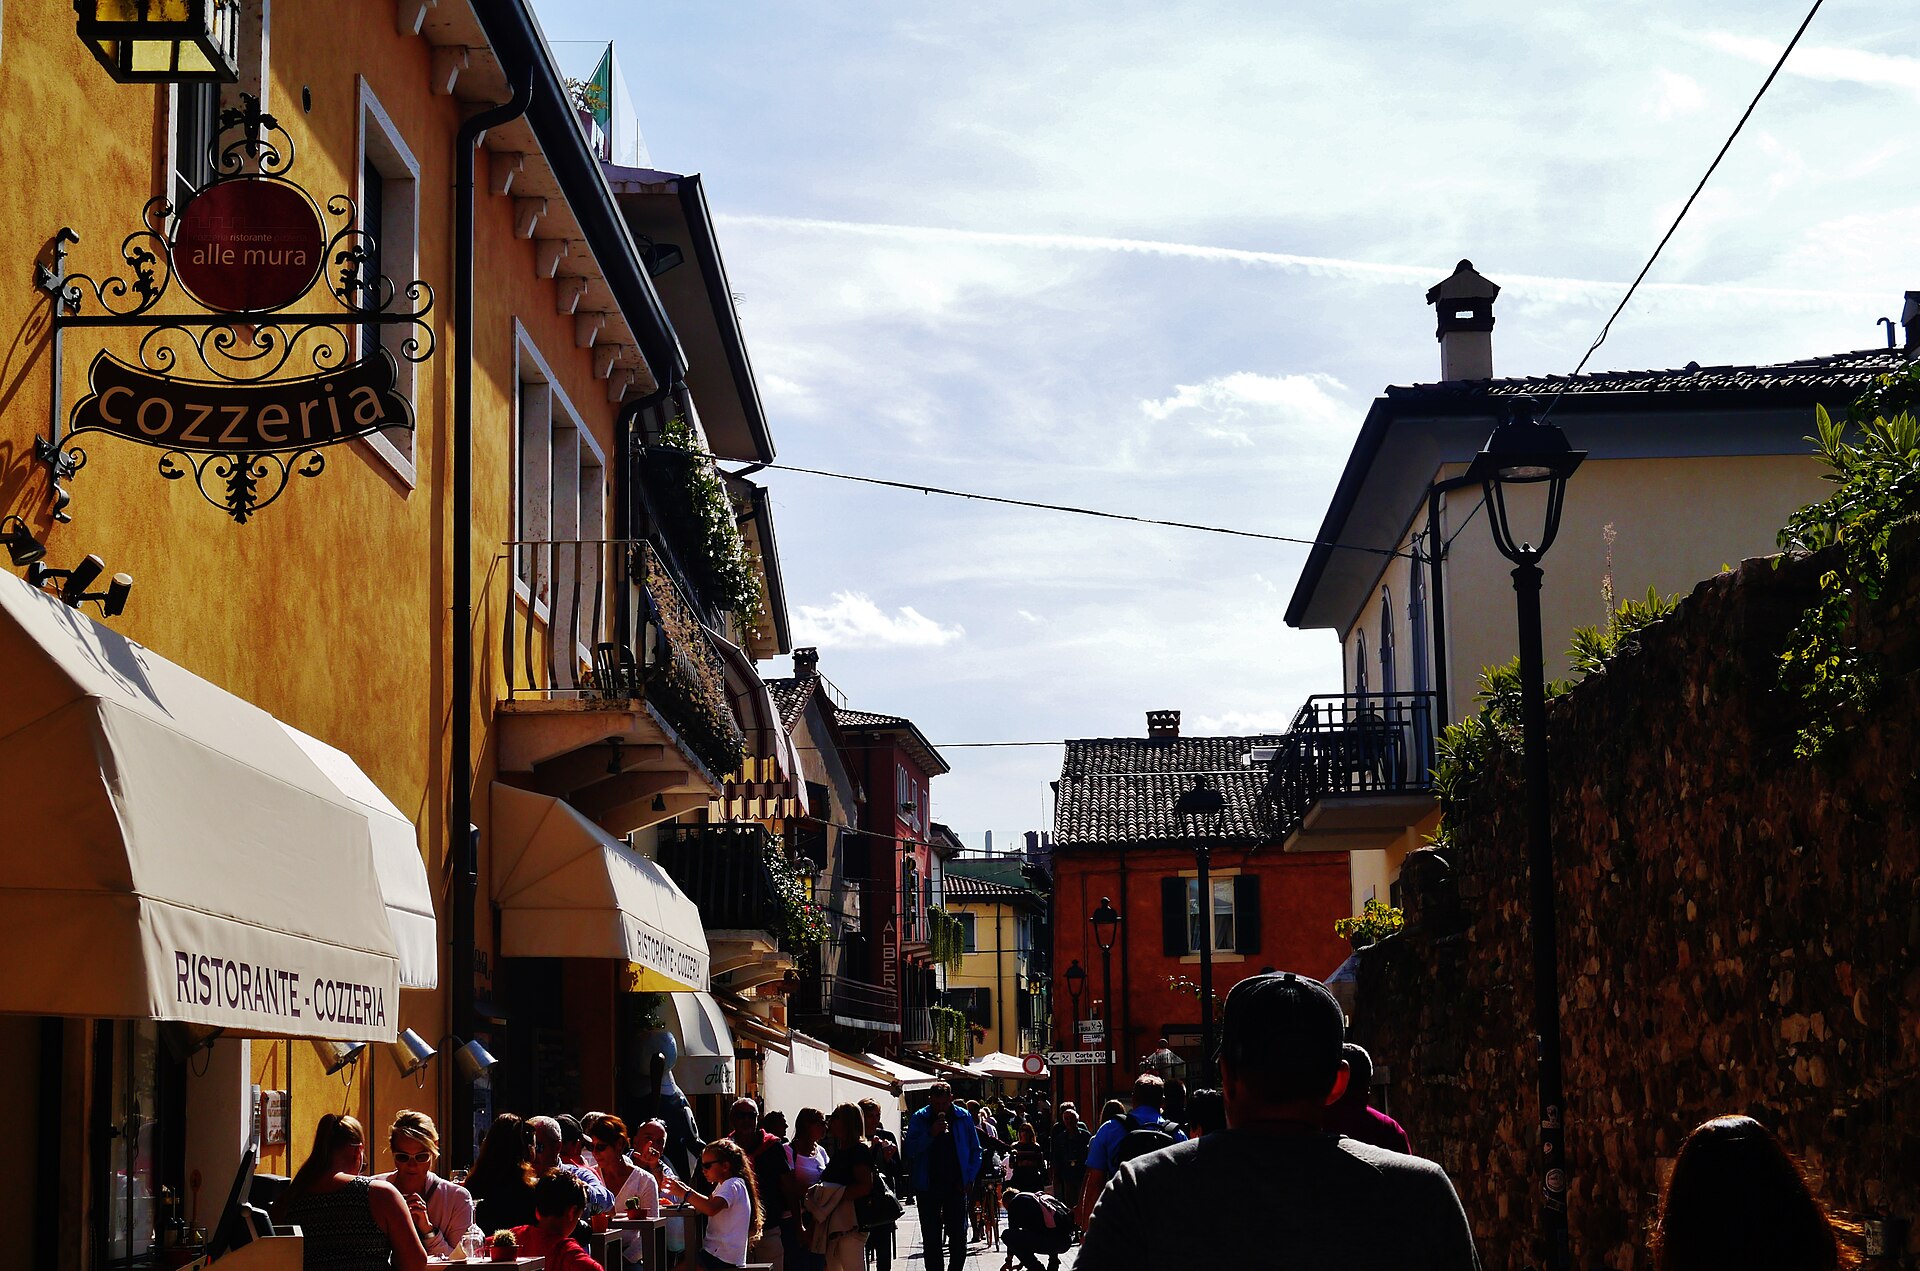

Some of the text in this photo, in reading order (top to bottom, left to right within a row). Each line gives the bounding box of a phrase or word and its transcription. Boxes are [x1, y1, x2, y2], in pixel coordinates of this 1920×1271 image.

[192, 243, 307, 266] alle mura
[230, 232, 273, 242] ristorante
[98, 383, 387, 443] cozzeria
[637, 929, 675, 973] RISTORANTE
[677, 951, 701, 984] COZZERIA
[174, 950, 301, 1018] RISTORANTE
[313, 977, 386, 1027] COZZERIA
